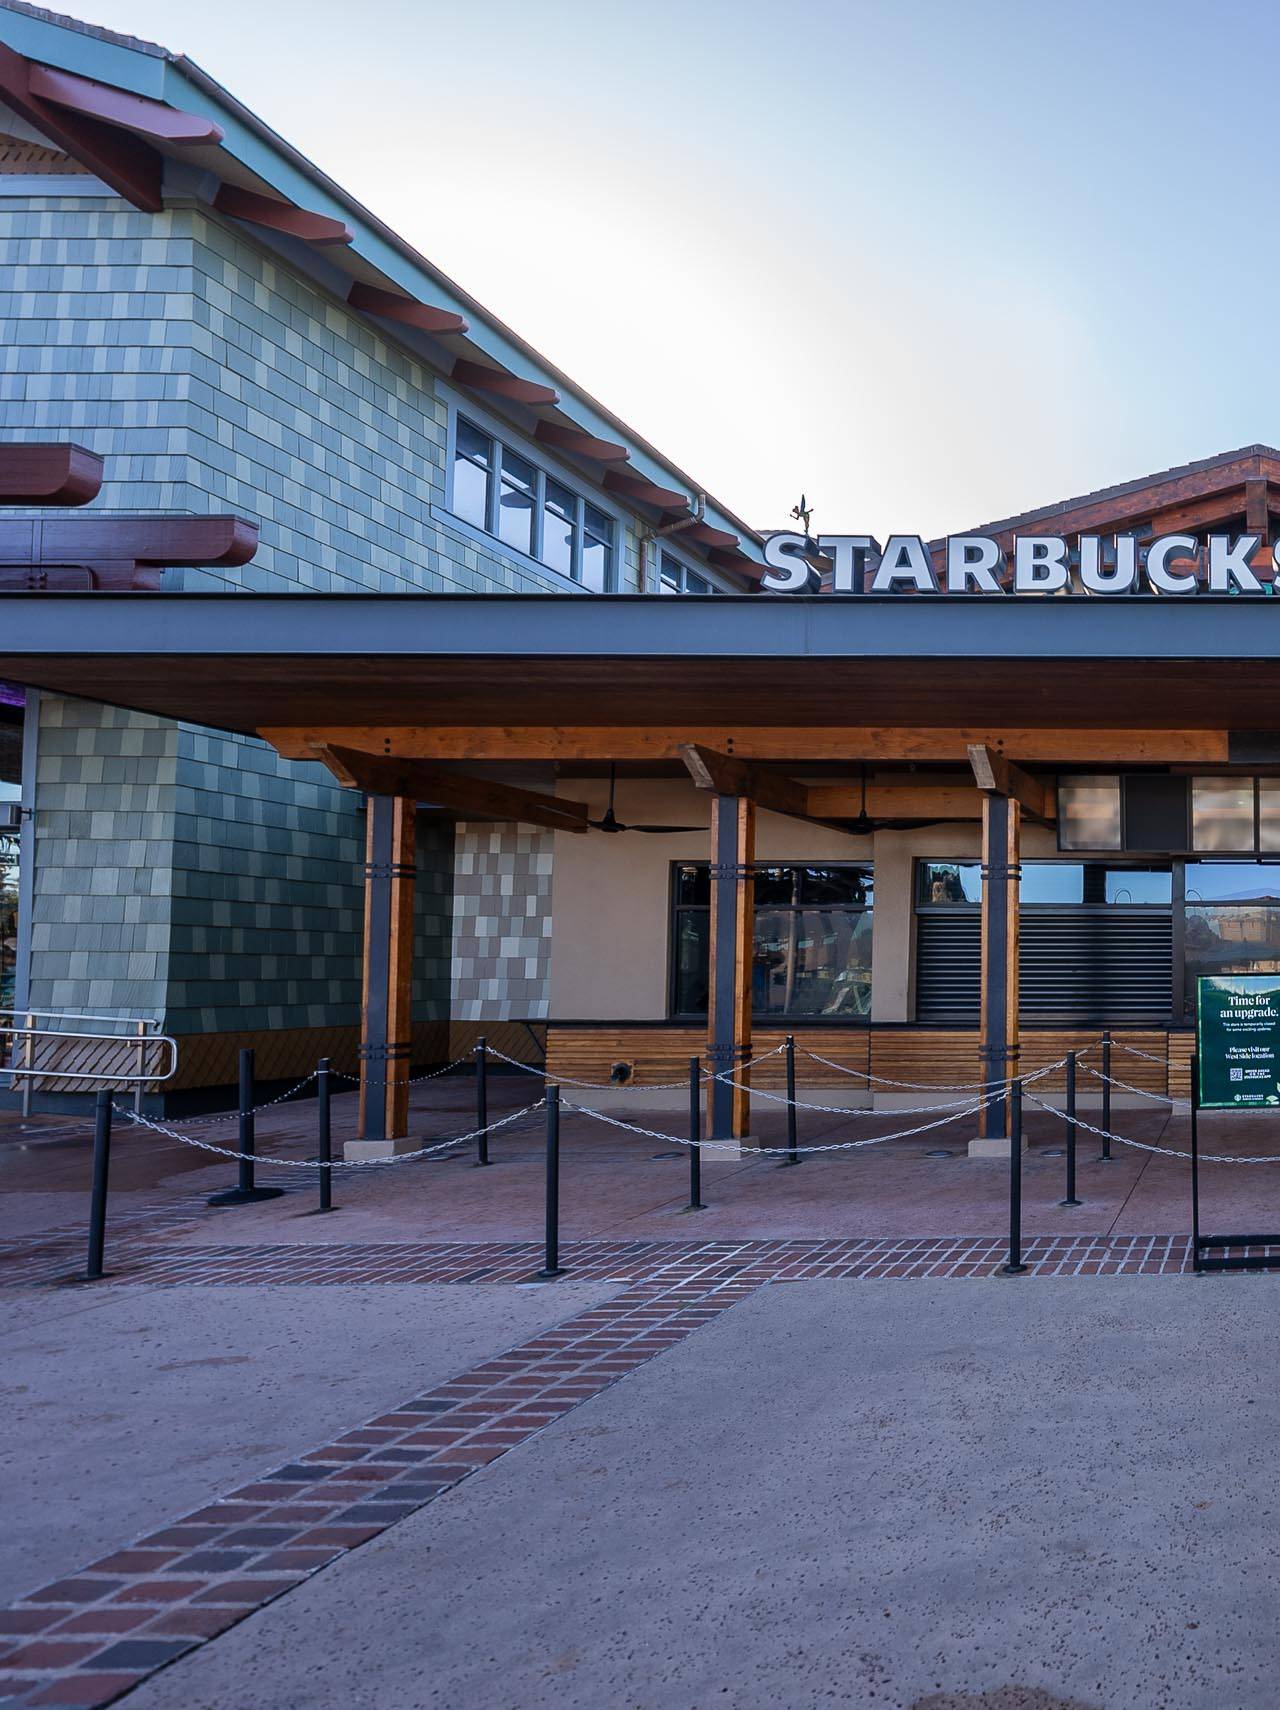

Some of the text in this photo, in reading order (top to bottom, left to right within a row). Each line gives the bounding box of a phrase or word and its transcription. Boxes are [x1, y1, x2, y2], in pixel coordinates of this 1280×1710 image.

[1228, 995, 1270, 1006] Time for
[1234, 1006, 1278, 1020] upgrade.
